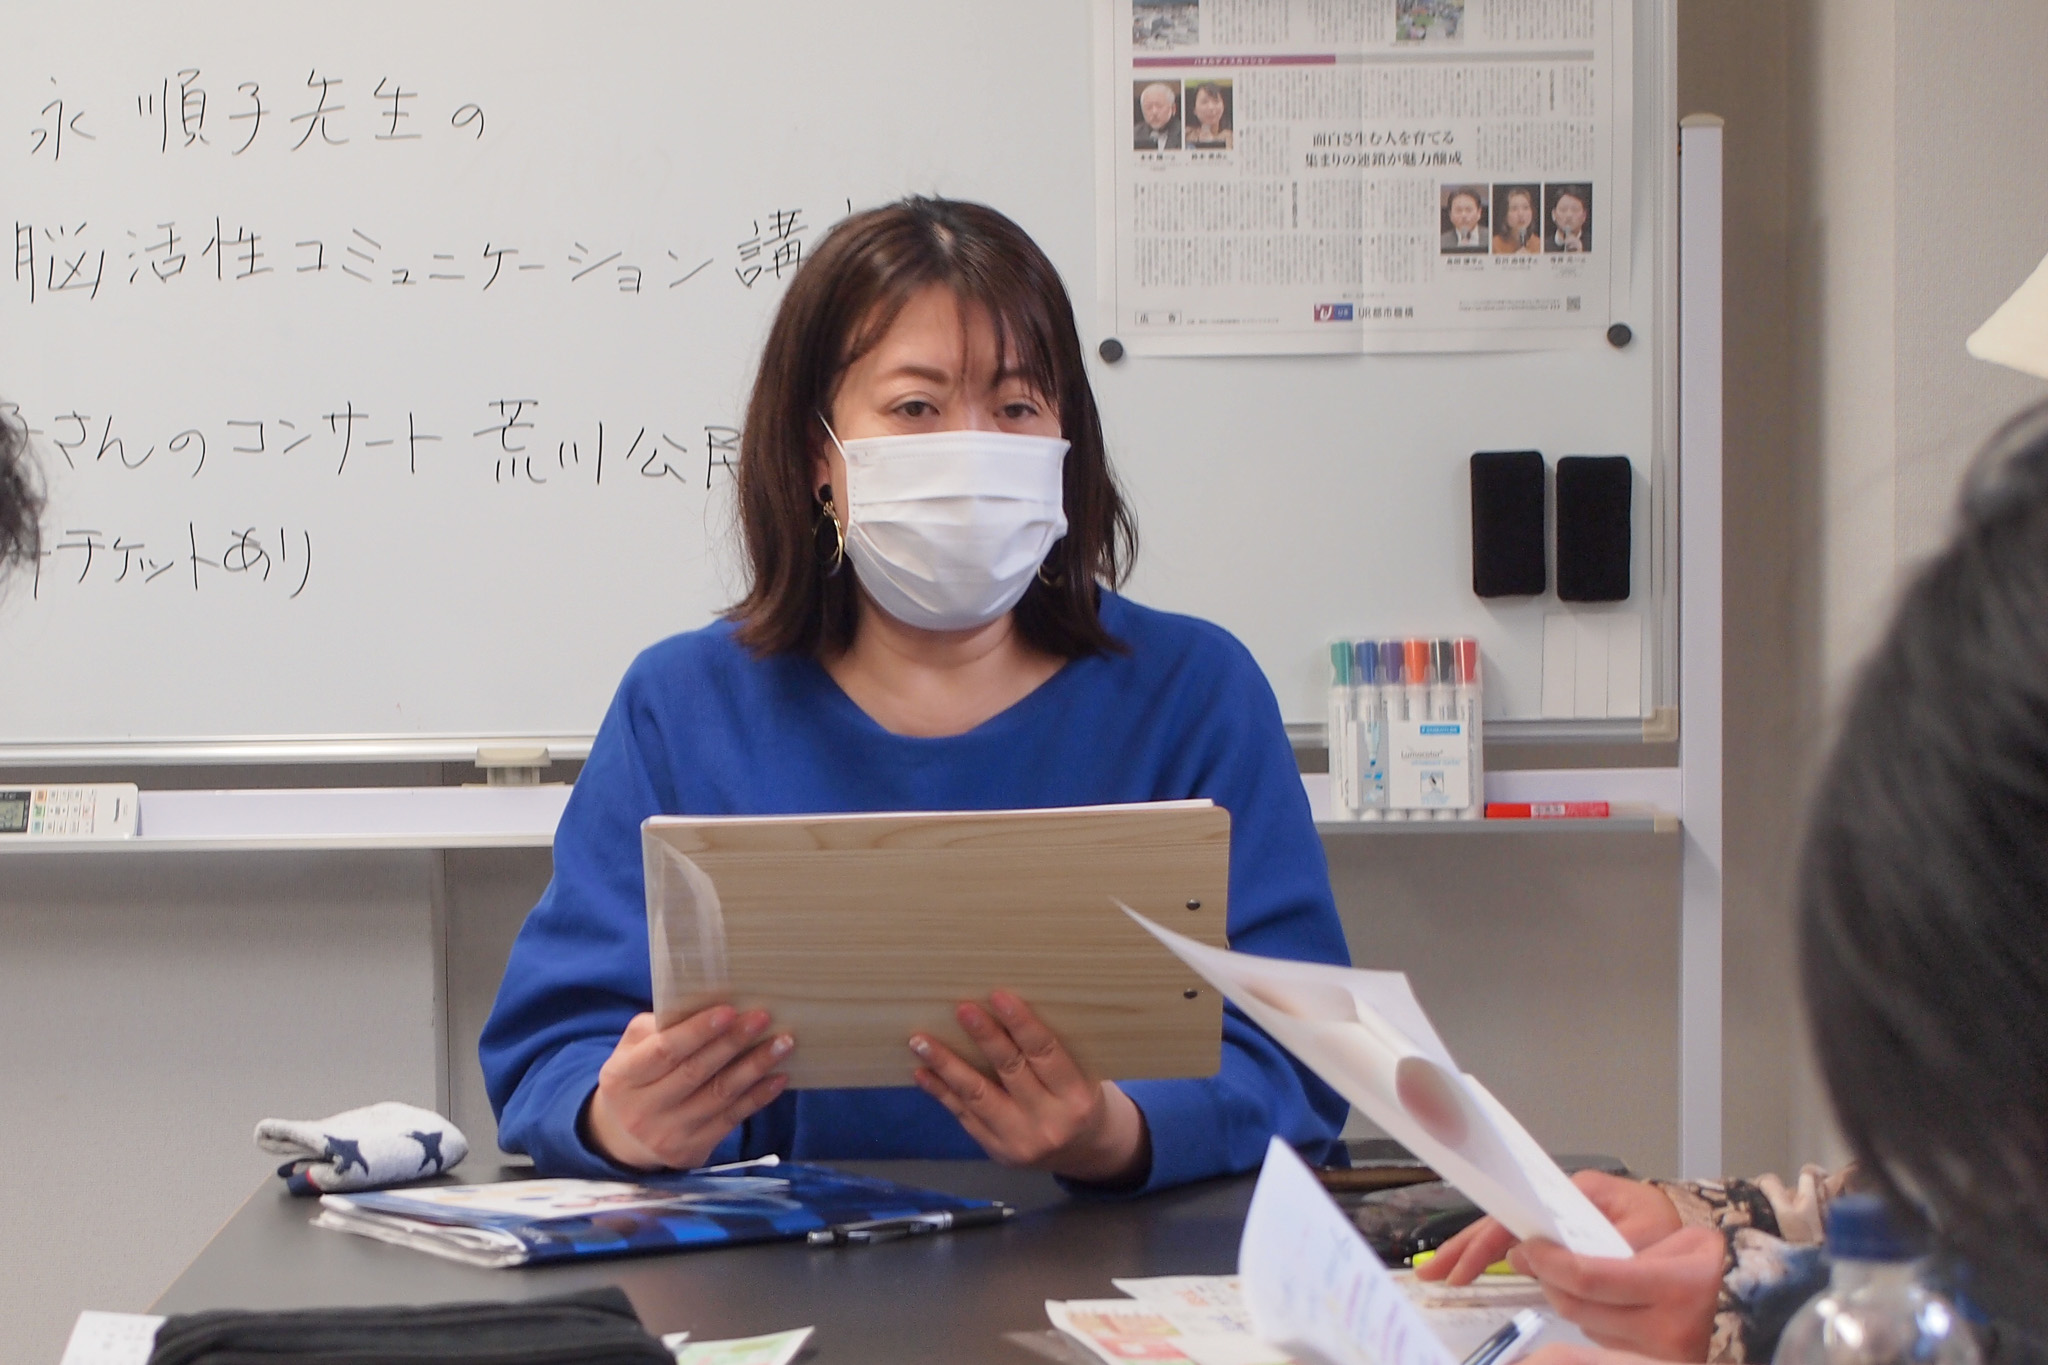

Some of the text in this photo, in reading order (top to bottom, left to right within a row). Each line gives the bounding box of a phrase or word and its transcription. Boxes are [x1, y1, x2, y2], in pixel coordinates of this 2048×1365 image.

[31, 68, 486, 161] 永 順子先生の
[1312, 131, 1455, 148] 面白さ生む人を育てる
[1304, 151, 1463, 168] 集まりの連鎖が魅力醸成
[15, 197, 854, 303] 脳活性コミュニケーション講
